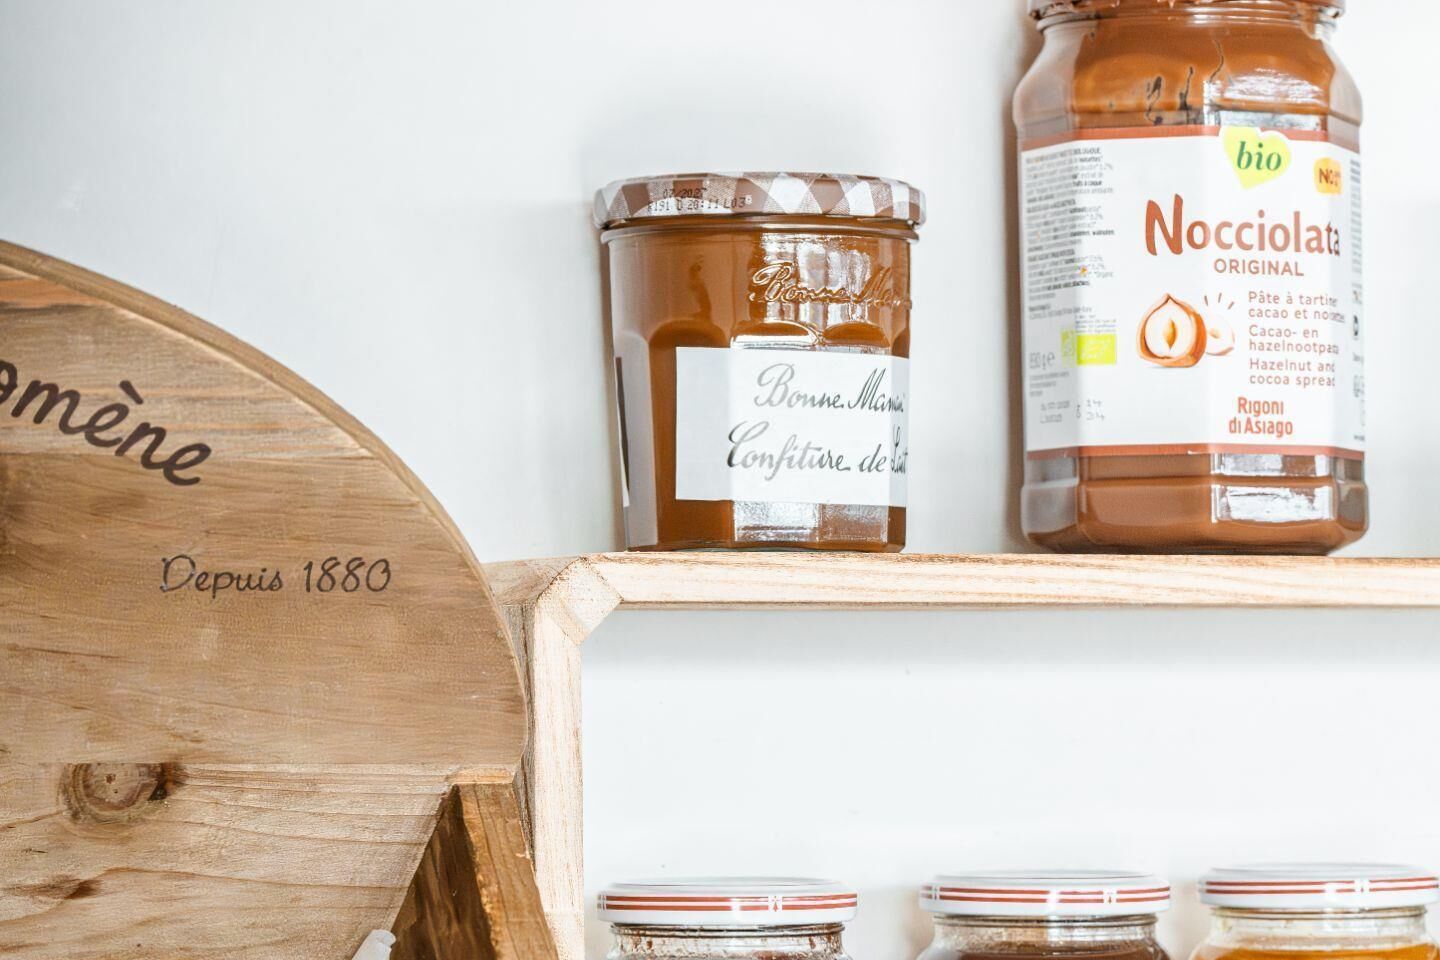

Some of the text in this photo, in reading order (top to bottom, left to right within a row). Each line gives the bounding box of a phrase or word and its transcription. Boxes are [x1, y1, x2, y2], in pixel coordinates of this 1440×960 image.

[1237, 141, 1282, 171] bio
[1145, 193, 1340, 256] Nocciolata
[1214, 257, 1305, 277] ORIGINAL
[1248, 290, 1280, 305] Pâte
[1286, 291, 1294, 305] à
[1248, 308, 1289, 319] cacao
[1294, 308, 1309, 320] et
[1249, 324, 1319, 339] Cacao- en
[1249, 357, 1312, 373] Hazelnut
[753, 362, 844, 408] Bonne
[1249, 375, 1290, 385] cocoa
[1237, 396, 1285, 418] Rigoni
[1228, 417, 1294, 438] di Asiago
[727, 420, 851, 482] Confiture
[858, 443, 888, 474] de
[160, 554, 392, 600] Depuis 1880
